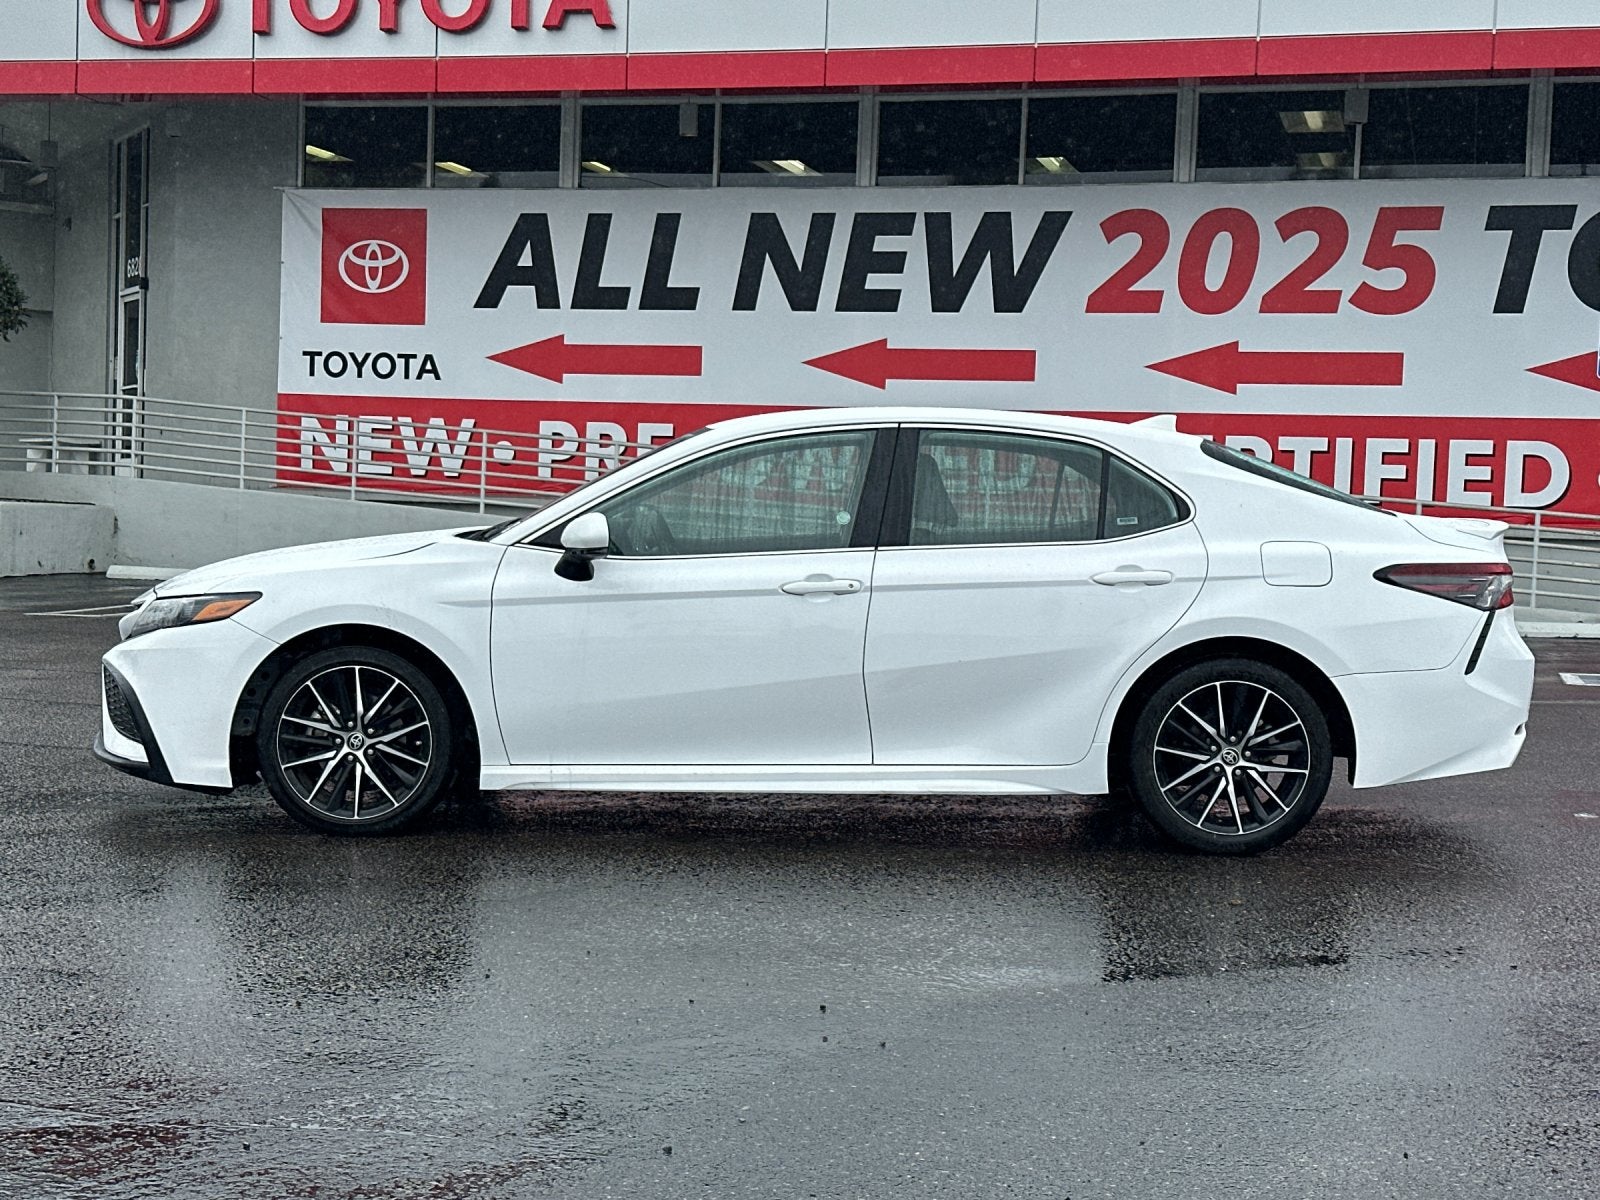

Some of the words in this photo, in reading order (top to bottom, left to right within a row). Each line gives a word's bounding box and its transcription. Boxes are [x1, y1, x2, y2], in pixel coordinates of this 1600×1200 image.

[473, 213, 701, 310] ALL
[731, 210, 1073, 313] NEW
[1085, 206, 1444, 315] 2025
[302, 350, 442, 381] TOYOTA
[300, 415, 476, 478] NEW
